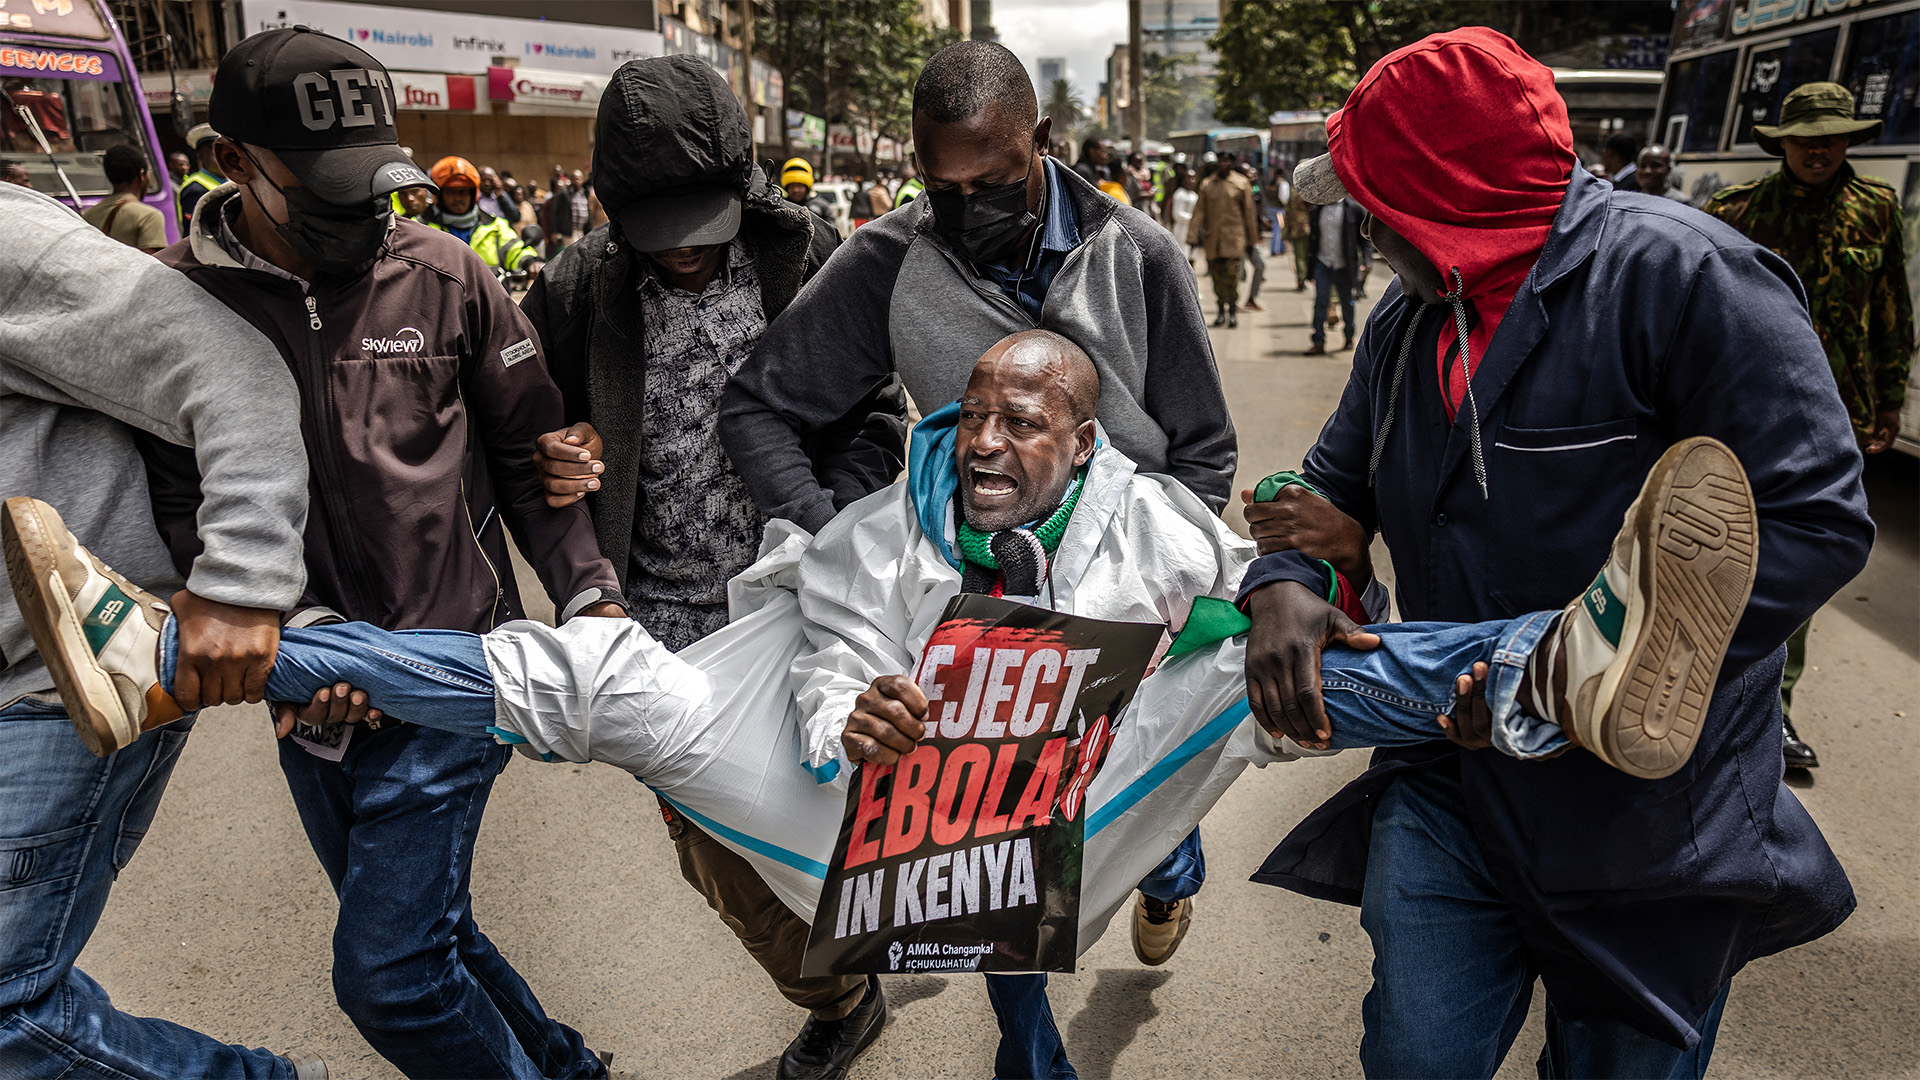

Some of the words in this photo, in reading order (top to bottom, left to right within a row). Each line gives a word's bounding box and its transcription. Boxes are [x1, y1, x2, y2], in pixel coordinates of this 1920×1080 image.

[372, 30, 434, 48] Nairobi
[452, 36, 506, 52] Infinix
[545, 44, 596, 59] Nairobi
[293, 68, 393, 131] GET
[387, 167, 425, 183] GET
[915, 644, 1101, 739] EJECT
[843, 736, 1068, 871] EBOLA
[834, 867, 886, 940] IN
[893, 837, 1038, 928] KENYA
[906, 942, 941, 957] AMKA
[942, 942, 994, 958] Changamka!
[905, 958, 976, 970] #CHUKUAHATUA
